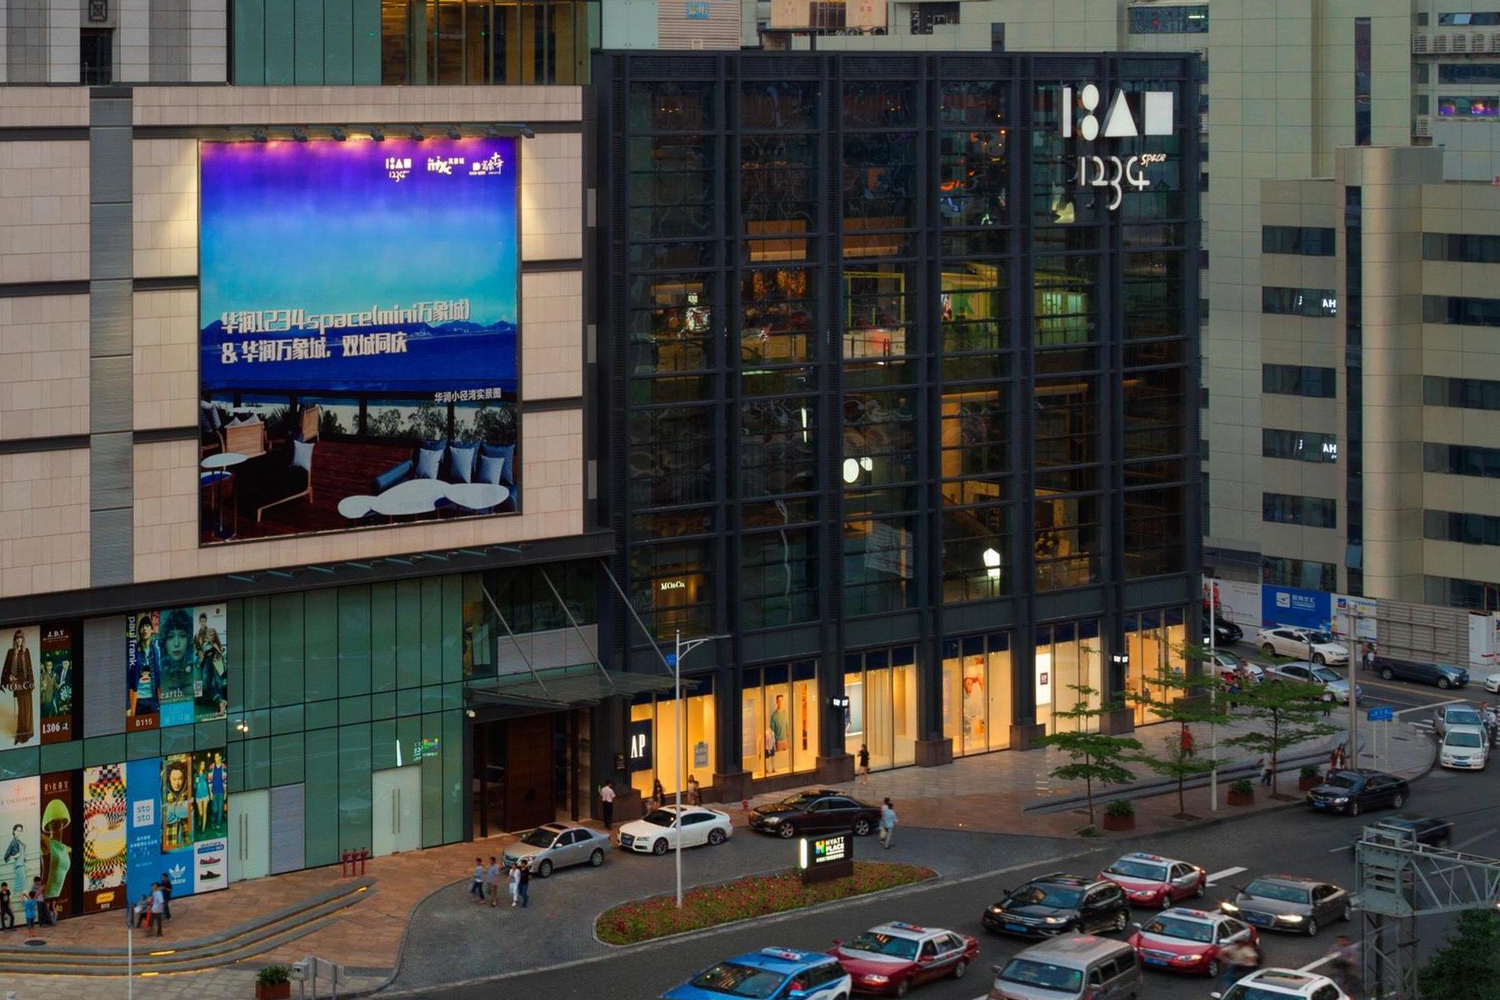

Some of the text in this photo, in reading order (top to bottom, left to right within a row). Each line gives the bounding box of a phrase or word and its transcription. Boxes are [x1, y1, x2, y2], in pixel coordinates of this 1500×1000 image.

[1080, 152, 1167, 211] 1234 space
[221, 342, 238, 364] &
[342, 331, 408, 357] 双城同庆
[434, 387, 502, 404] 华润小径湾实景图
[127, 616, 137, 667] paul frank
[136, 802, 151, 814] sto
[136, 812, 151, 823] sto
[825, 836, 845, 846] HYATT
[825, 843, 845, 852] PLACE
